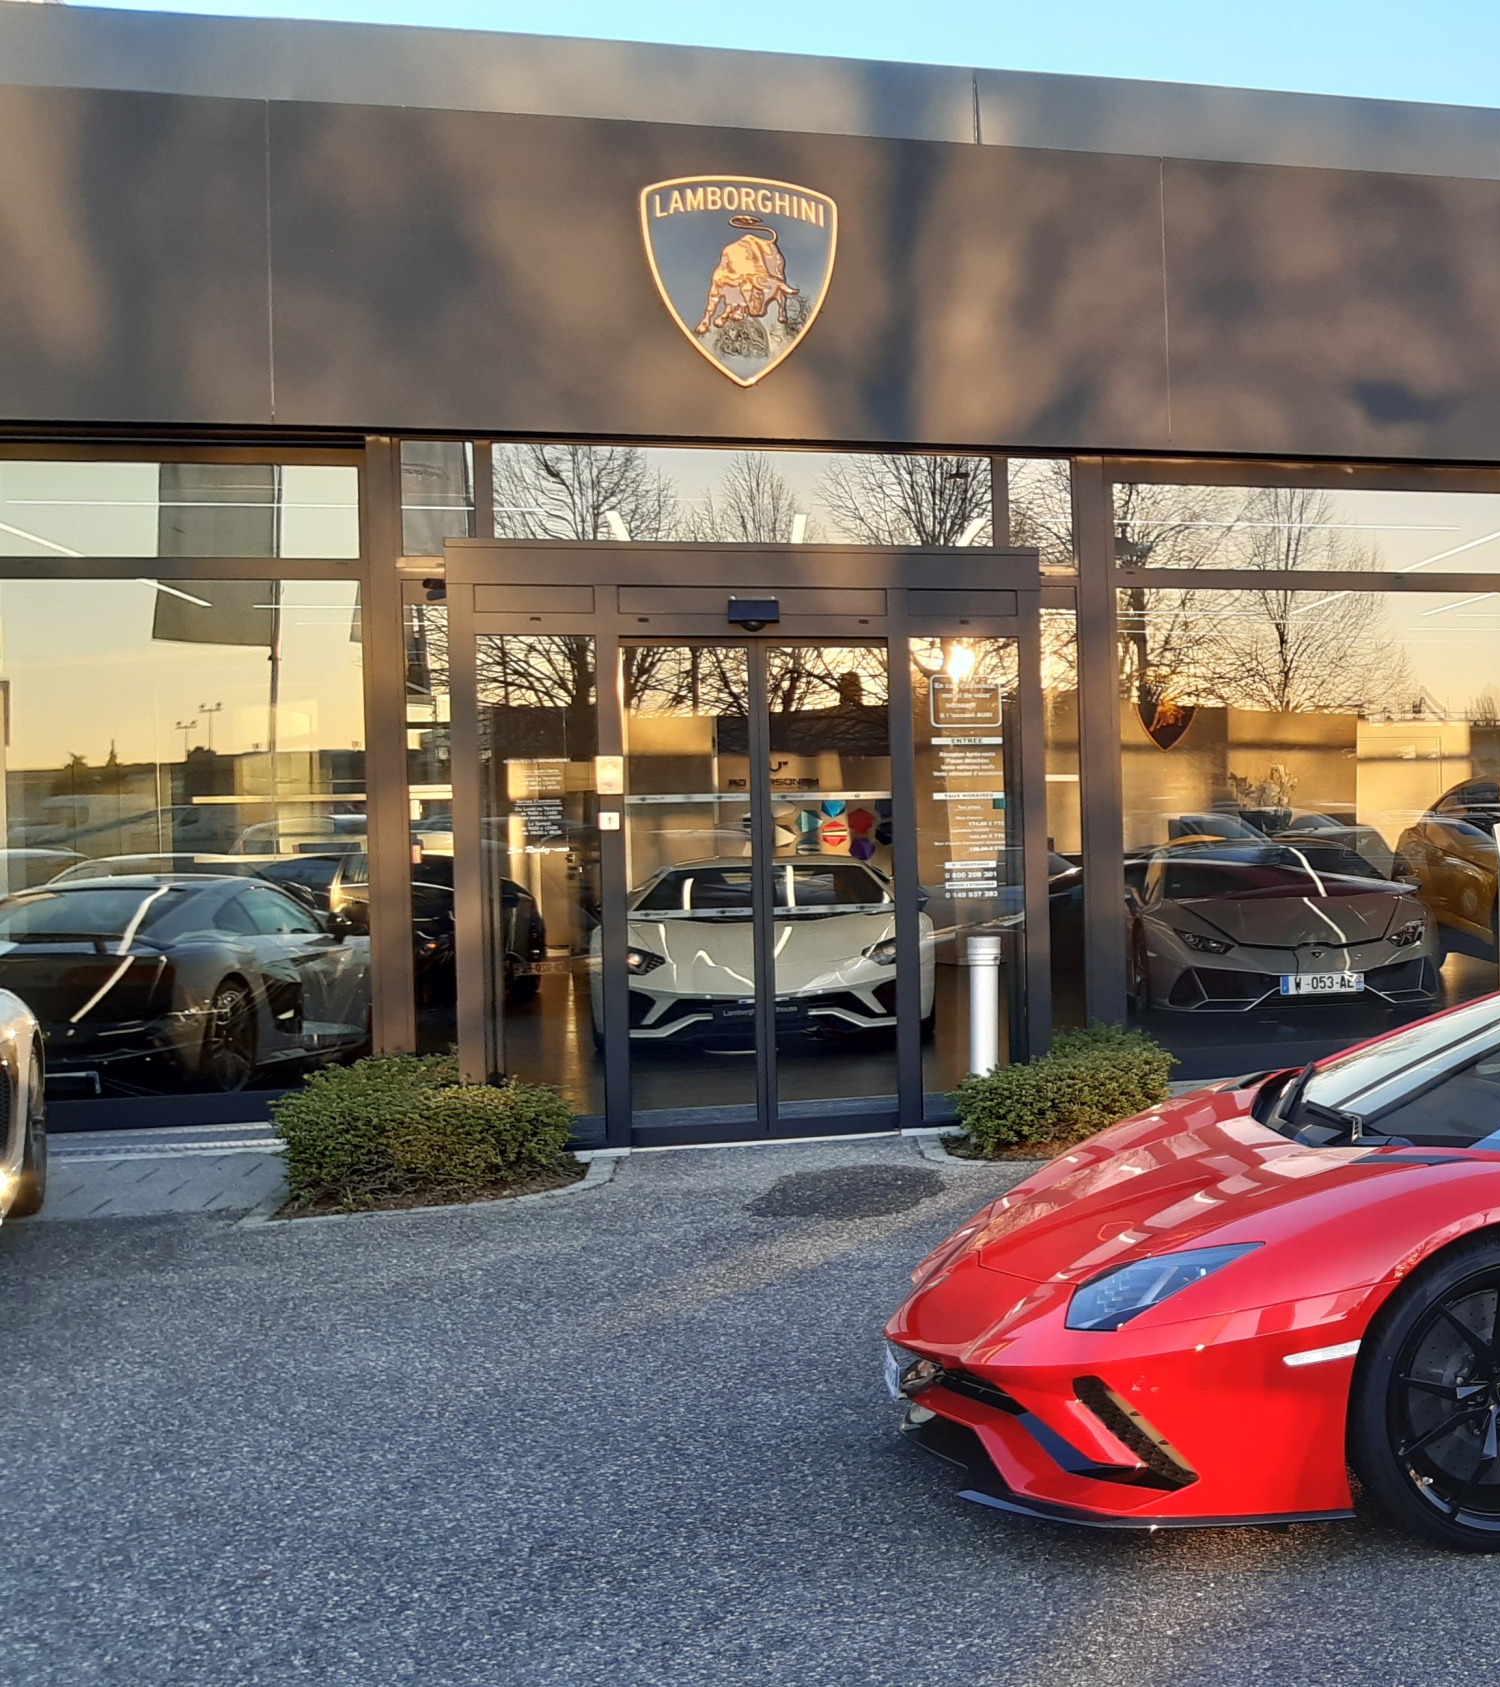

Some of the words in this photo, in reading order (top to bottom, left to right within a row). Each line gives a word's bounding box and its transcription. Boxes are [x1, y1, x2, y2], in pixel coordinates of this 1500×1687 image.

[653, 186, 826, 229] LAMBORGHINI
[728, 778, 747, 787] AD
[723, 1008, 756, 1017] Lamborg
